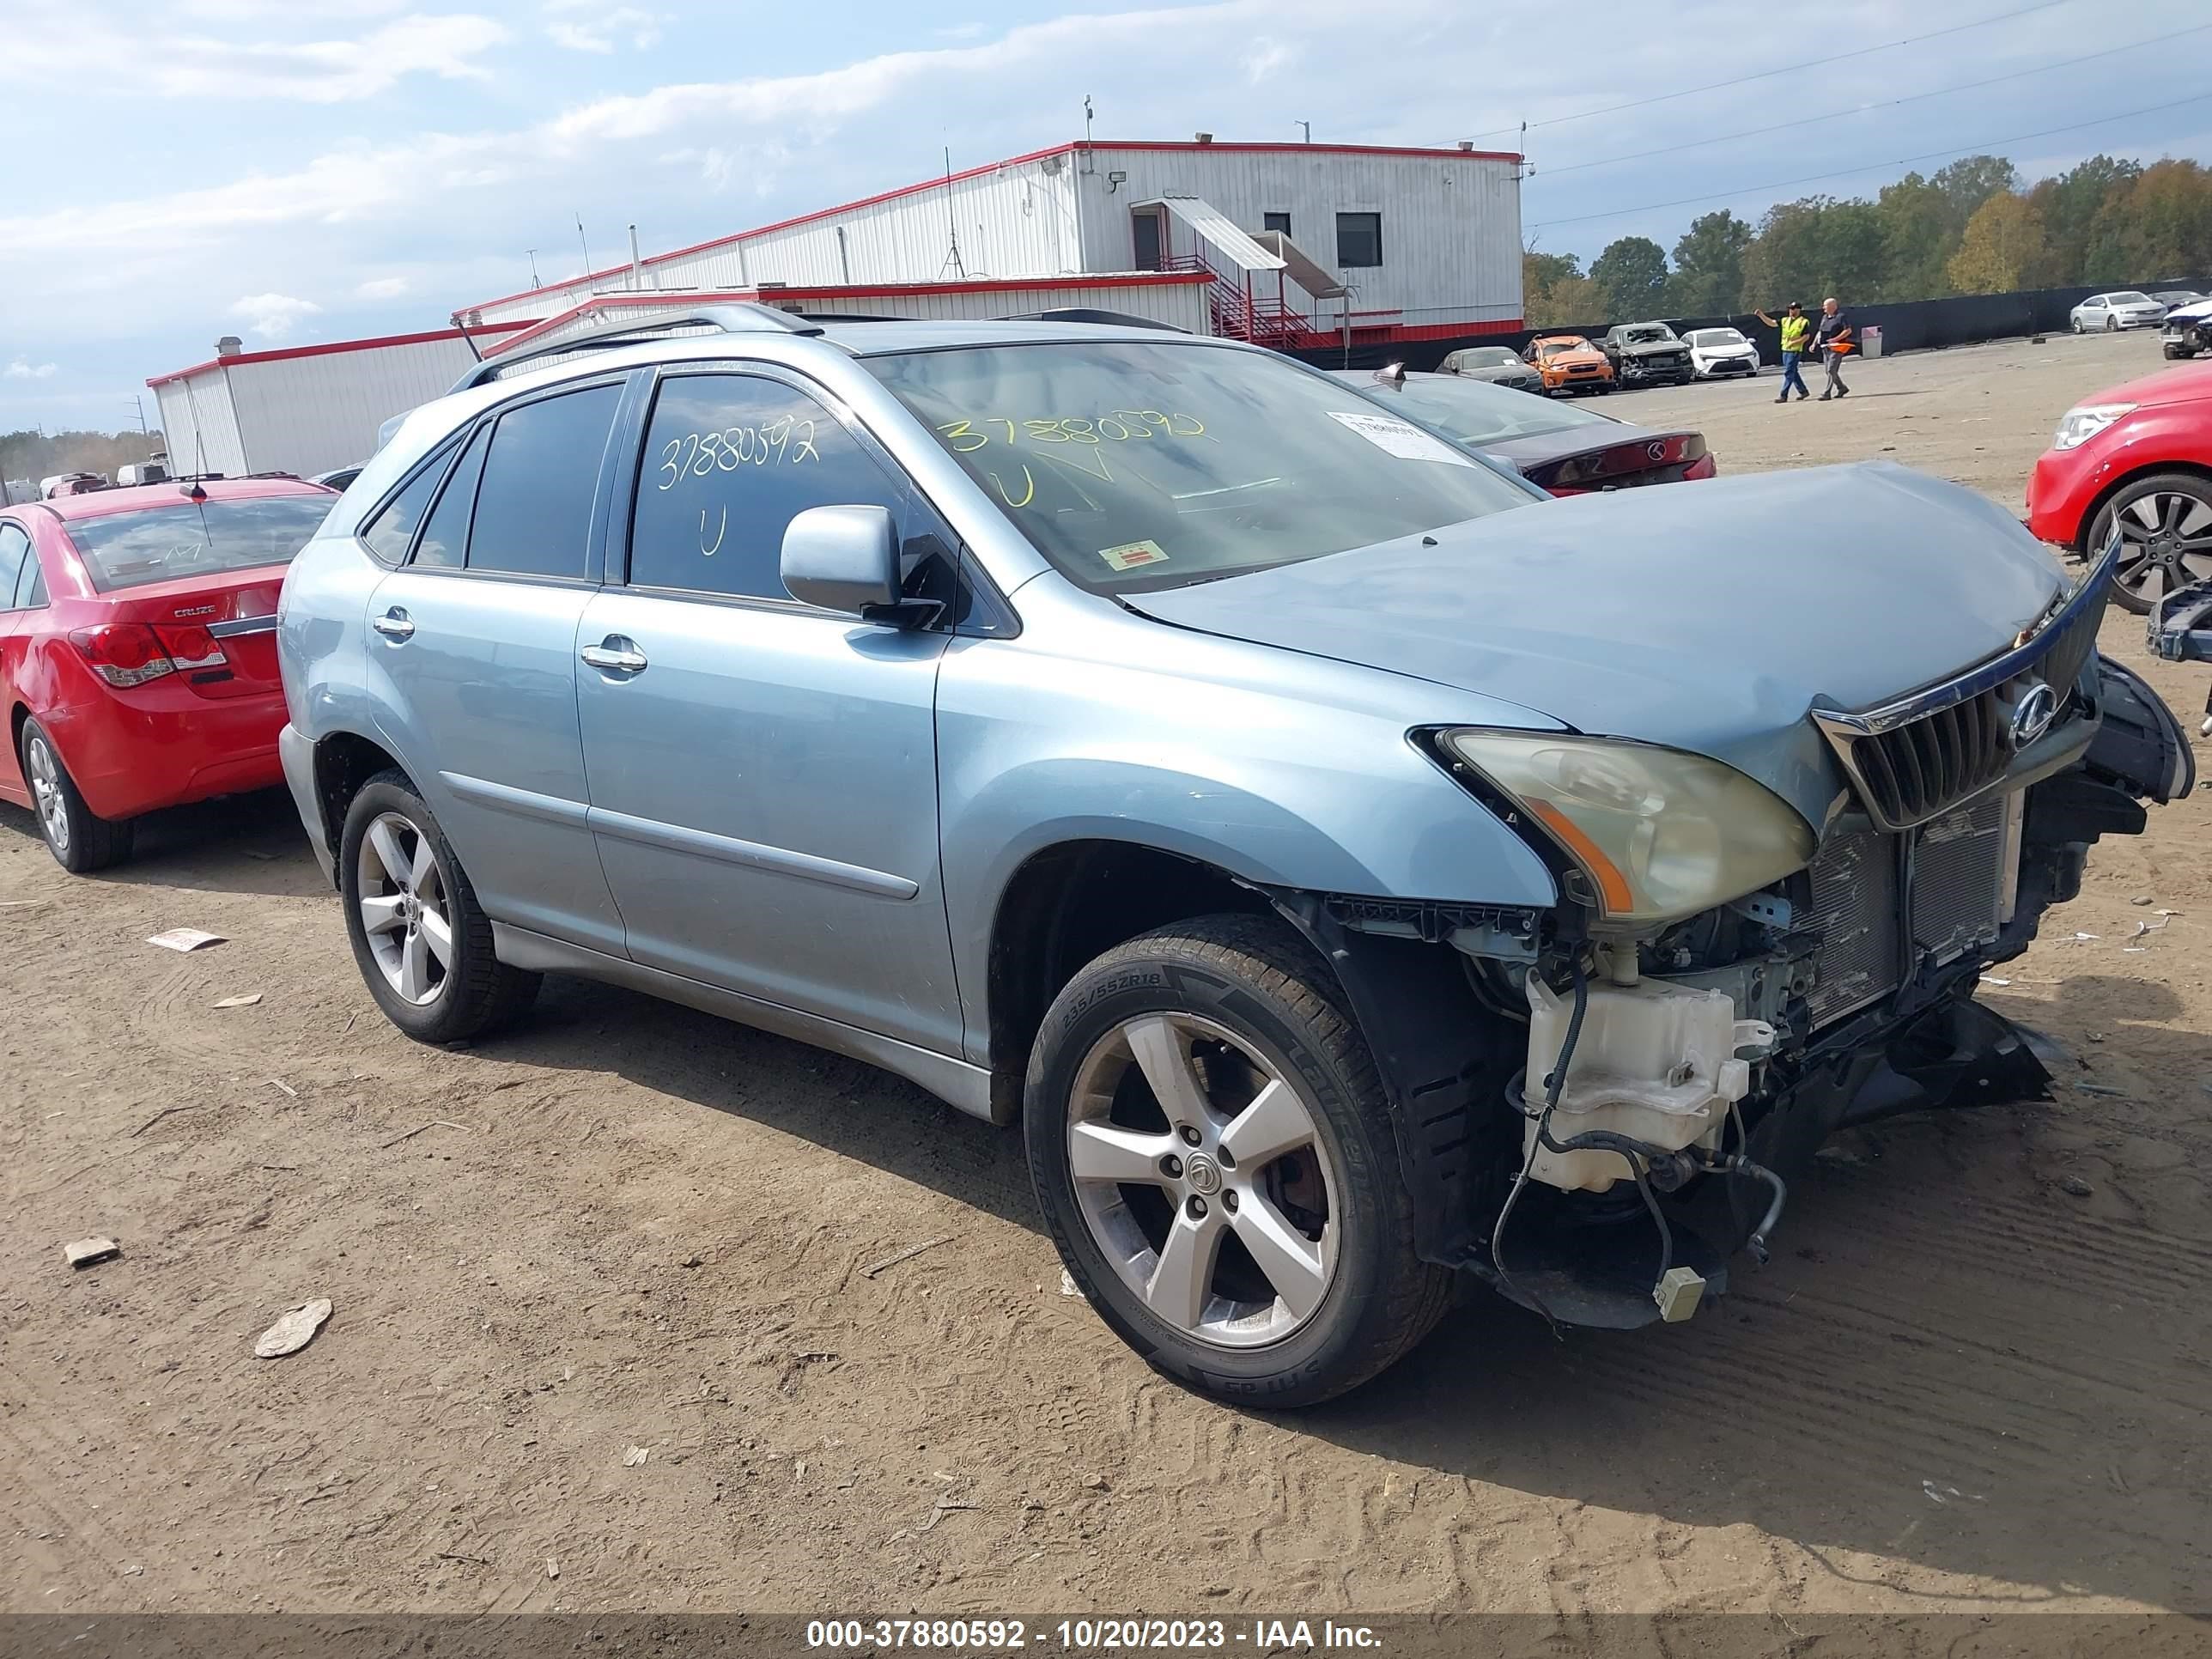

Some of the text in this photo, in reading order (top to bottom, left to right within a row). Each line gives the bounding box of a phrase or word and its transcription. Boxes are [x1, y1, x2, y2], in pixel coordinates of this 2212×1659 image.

[659, 415, 819, 490] 37880592
[937, 410, 1220, 452] 37880592
[989, 464, 1033, 507] U
[700, 502, 726, 556] U
[174, 605, 216, 618] CRUZE
[1063, 973, 1160, 1030] 235/55ZR18
